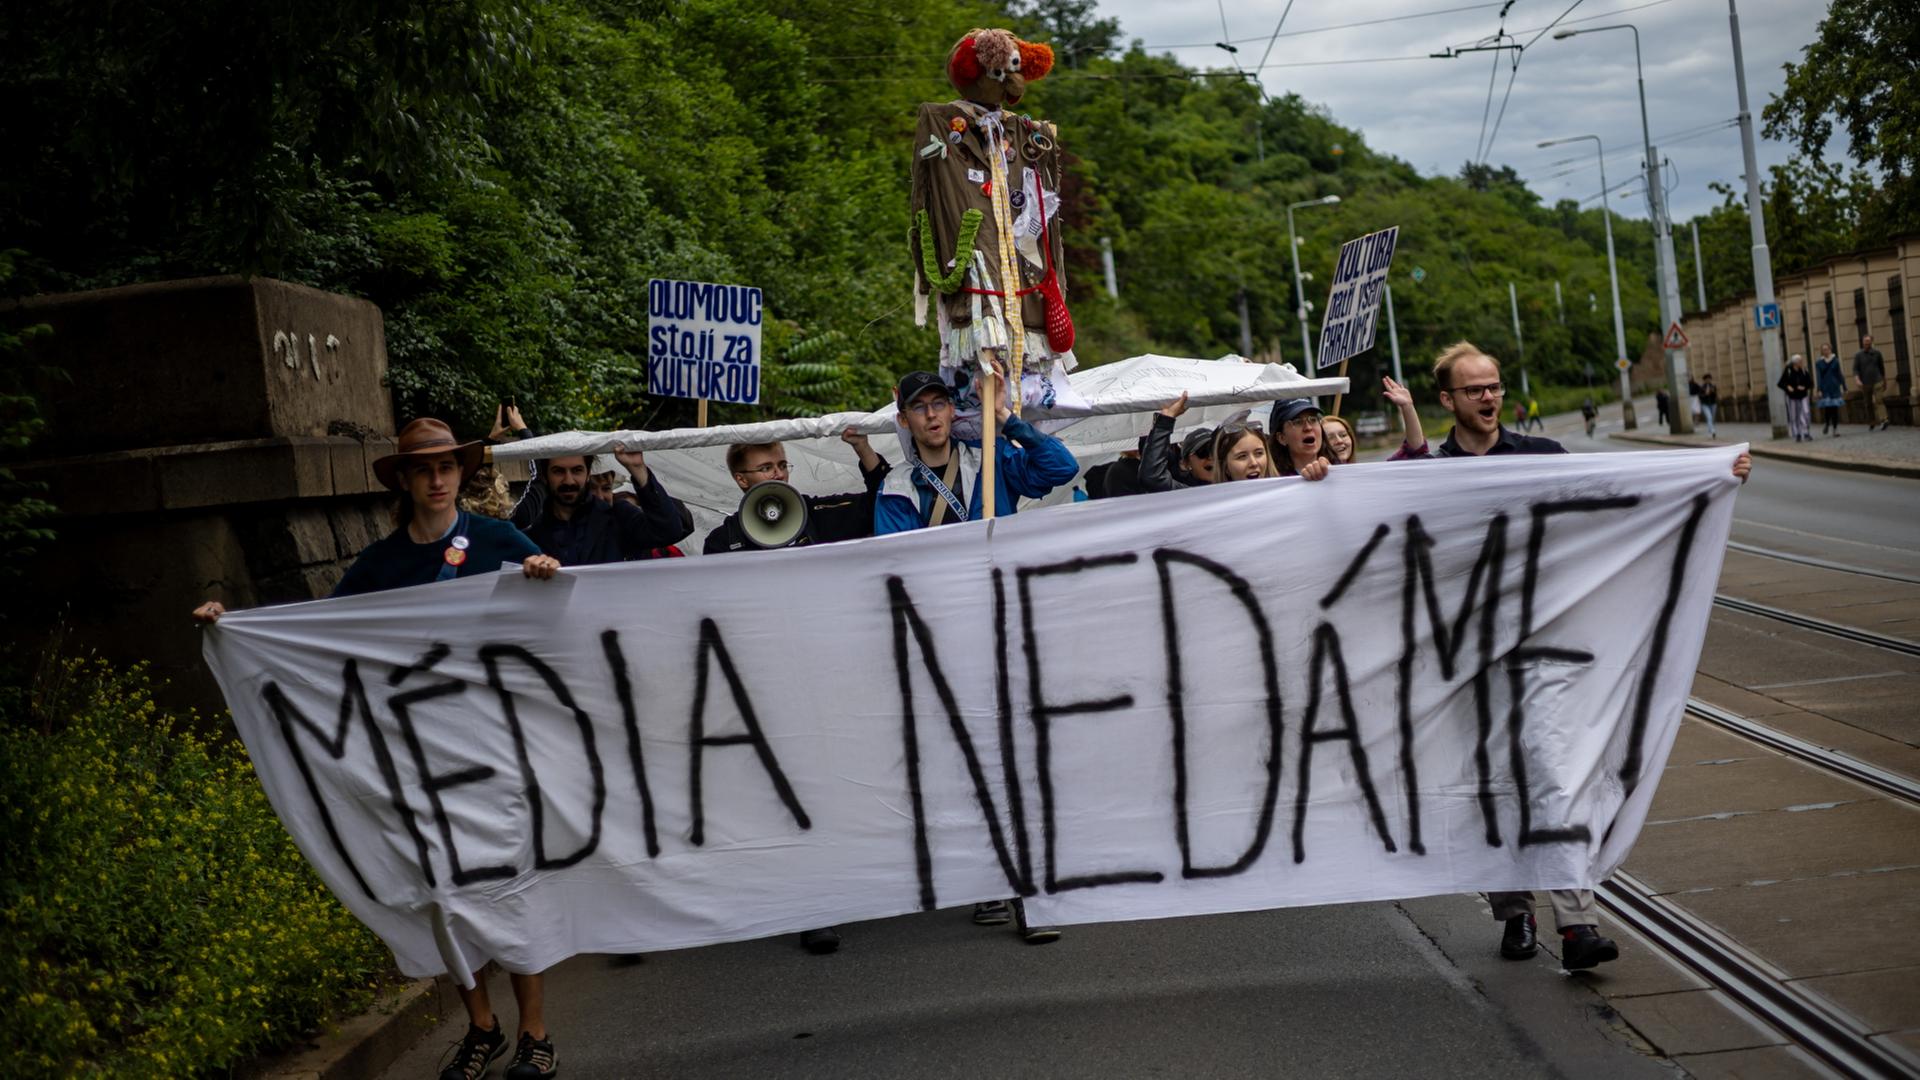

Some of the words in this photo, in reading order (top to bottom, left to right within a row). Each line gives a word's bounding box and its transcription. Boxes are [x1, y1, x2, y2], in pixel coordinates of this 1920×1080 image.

[1334, 228, 1396, 285] KULTURA
[650, 279, 762, 325] OLOMOUC
[1358, 274, 1386, 312] všem
[651, 324, 714, 361] stojí
[723, 335, 753, 364] za
[650, 356, 759, 403] KULTUROU
[261, 616, 813, 901] MÉDIA
[886, 491, 1709, 912] NEDÁME!
